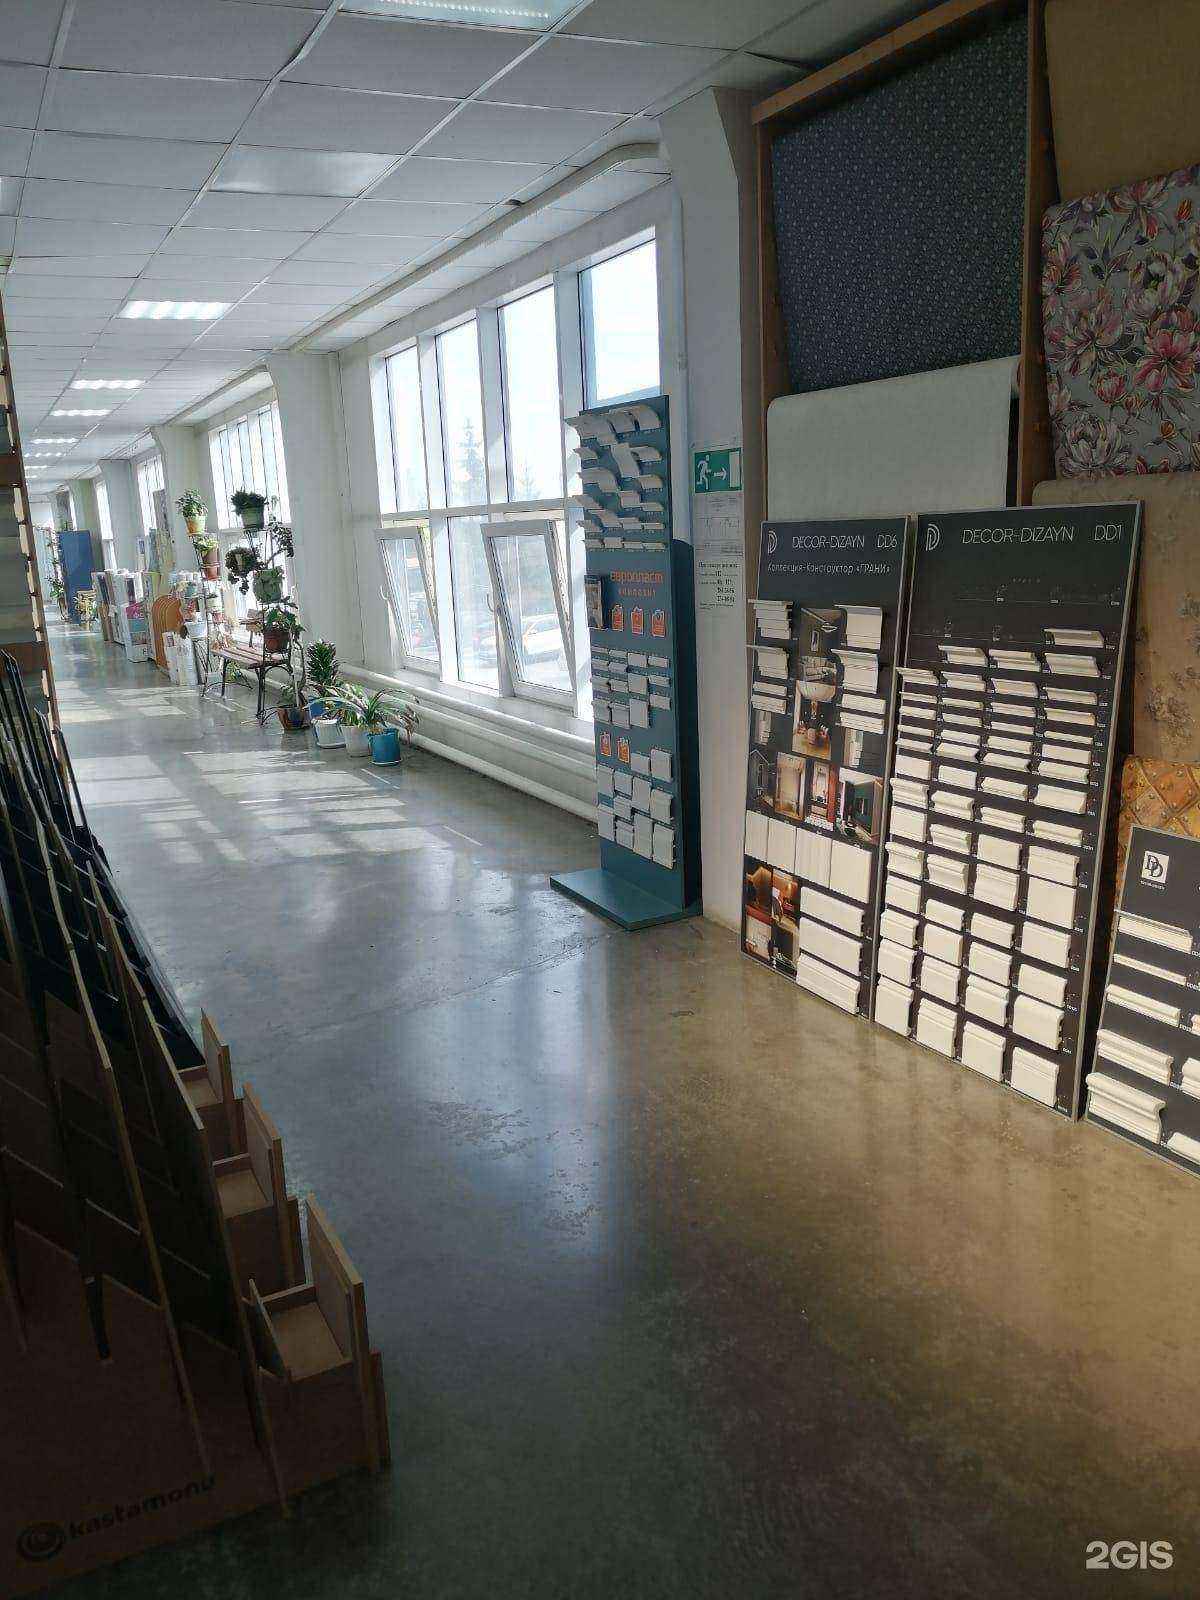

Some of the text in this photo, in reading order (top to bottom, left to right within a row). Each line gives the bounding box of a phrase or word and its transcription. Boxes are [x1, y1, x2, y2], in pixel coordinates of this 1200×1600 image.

[791, 534, 865, 549] DECOR-DIZAYN
[962, 523, 1124, 545] DECOR-DIZAYN DD1
[69, 1475, 216, 1538] kastamonu
